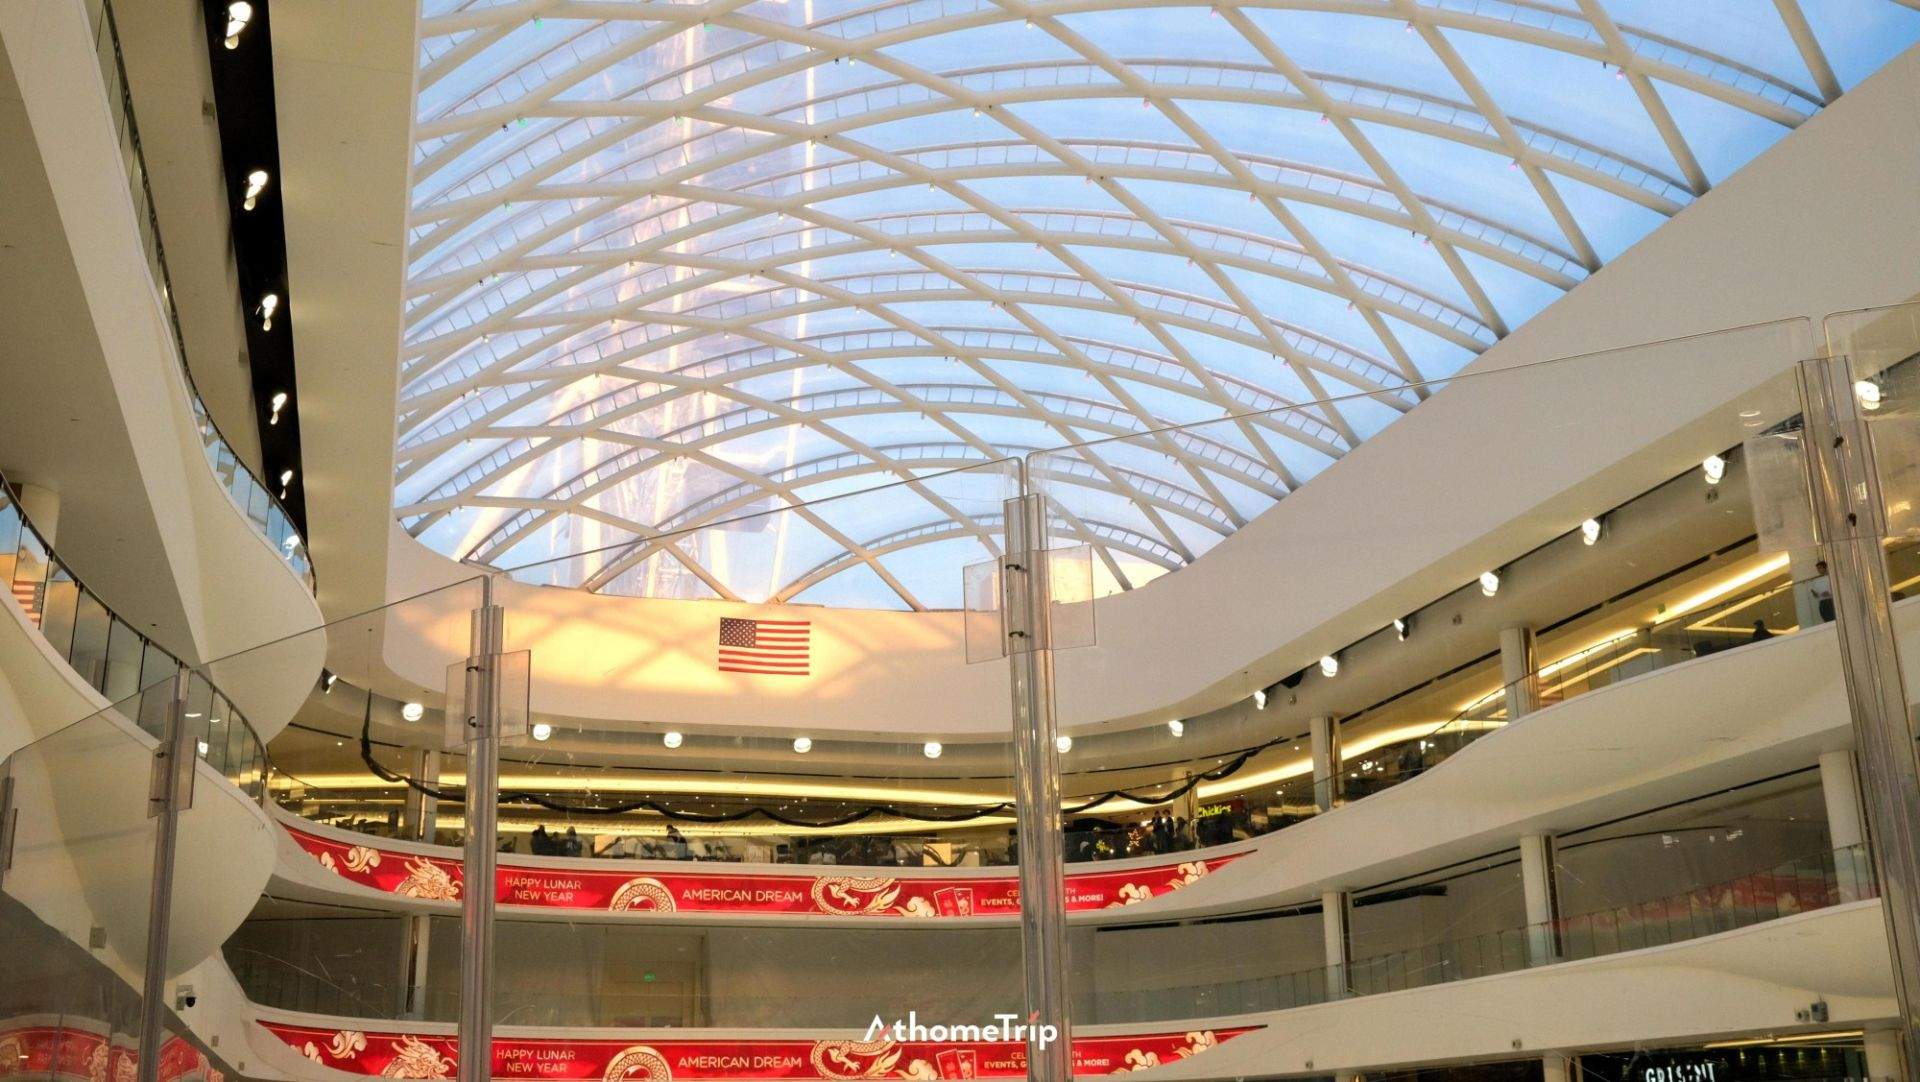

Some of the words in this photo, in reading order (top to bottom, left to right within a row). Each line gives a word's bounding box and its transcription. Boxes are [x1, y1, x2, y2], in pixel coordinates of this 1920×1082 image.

[505, 876, 541, 888] HAPPY
[544, 880, 582, 890] LUNAR
[514, 890, 540, 900] NEW
[544, 892, 574, 902] YEAR
[682, 889, 752, 901] AMERICAN
[755, 890, 803, 902] DREAM
[1078, 894, 1104, 903] MORE!
[496, 1049, 534, 1060] HAPPY
[537, 1050, 576, 1060] LUNAR
[506, 1062, 533, 1073] NEW
[536, 1062, 567, 1073] YEAR
[678, 1056, 749, 1069] AMERICAN
[753, 1057, 802, 1068] DREAM
[984, 1061, 1019, 1070] EVENTS,
[1083, 1058, 1110, 1067] MORE!
